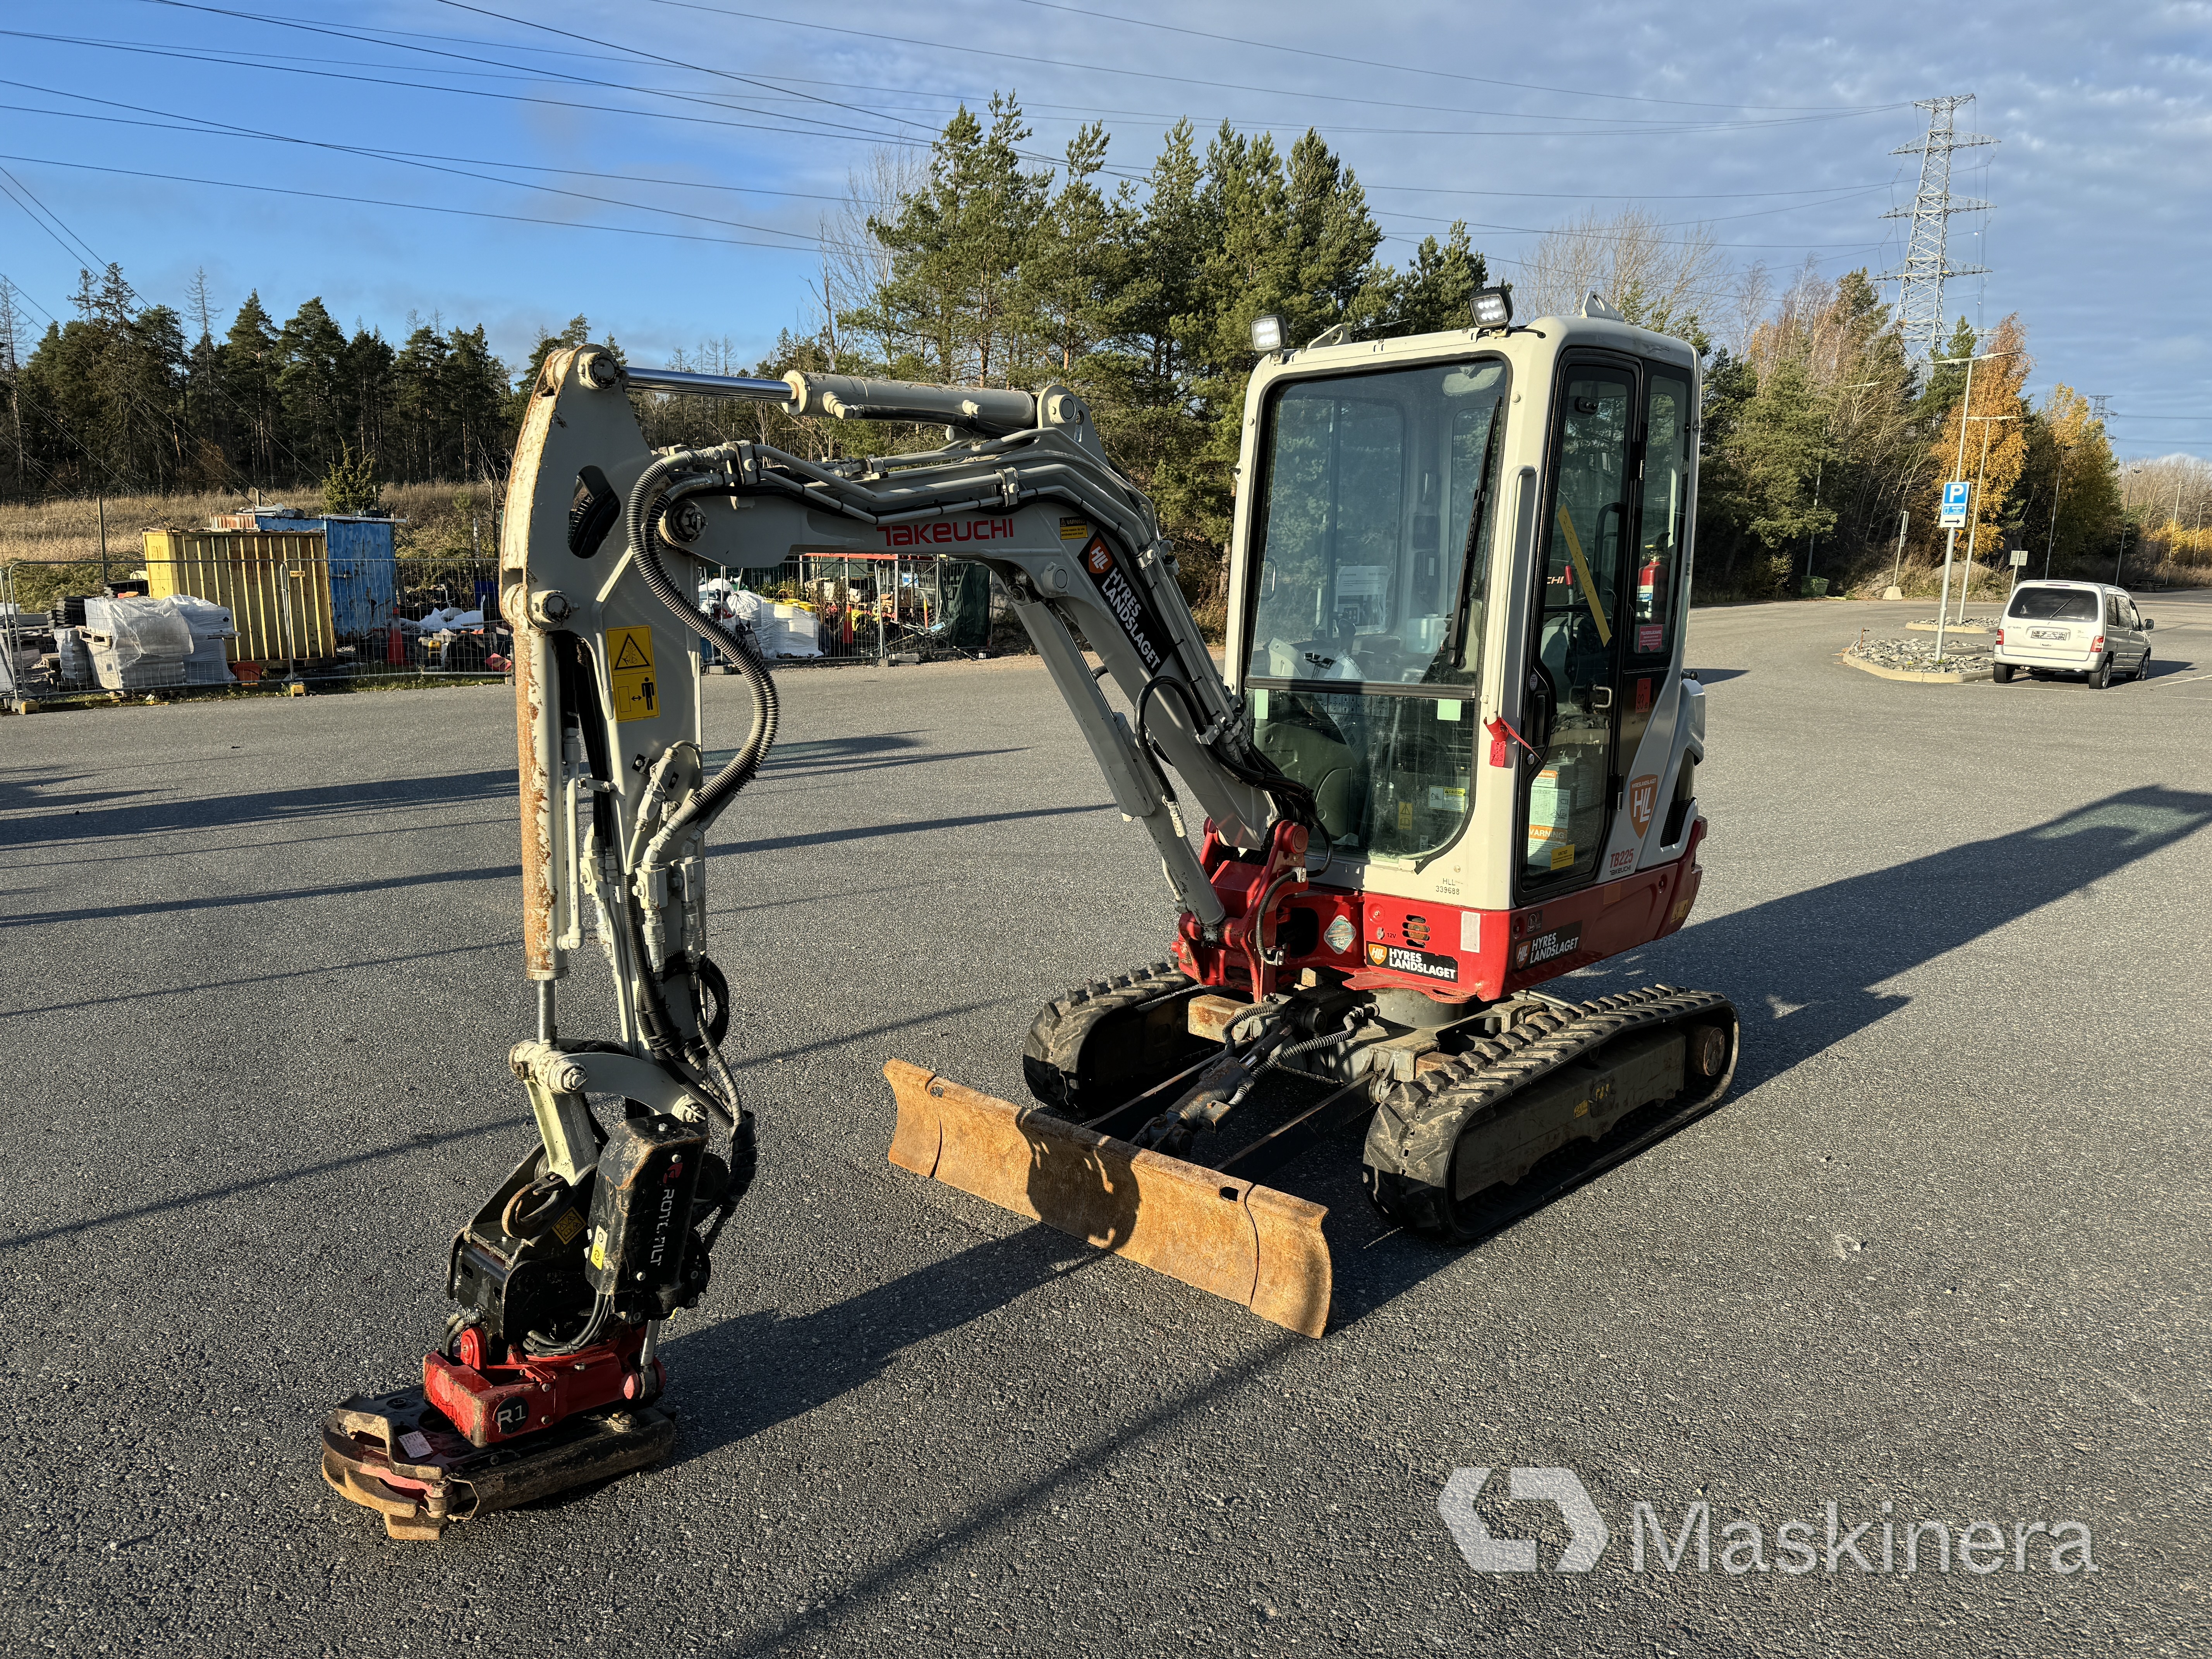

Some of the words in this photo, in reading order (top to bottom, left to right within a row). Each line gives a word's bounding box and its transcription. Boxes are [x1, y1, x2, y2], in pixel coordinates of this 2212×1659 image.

[1949, 484, 1964, 503] P
[876, 518, 1013, 546] TAKEUCHI
[1091, 546, 1108, 570] HLL
[1109, 567, 1141, 617] HYRES
[1101, 578, 1160, 669] LANDSLAGET
[1633, 787, 1651, 823] HLL
[1610, 848, 1634, 868] TB225
[1609, 865, 1631, 876] TAKEUCHI
[1436, 886, 1460, 895] 339688
[1530, 937, 1579, 964] LANDSLAGET
[1532, 933, 1557, 951] HYRES
[1371, 947, 1385, 960] HLL
[1389, 948, 1422, 963] HYRES
[1517, 945, 1528, 962] HLL
[1389, 957, 1456, 979] LANDSLAGET
[498, 1405, 526, 1426] R1
